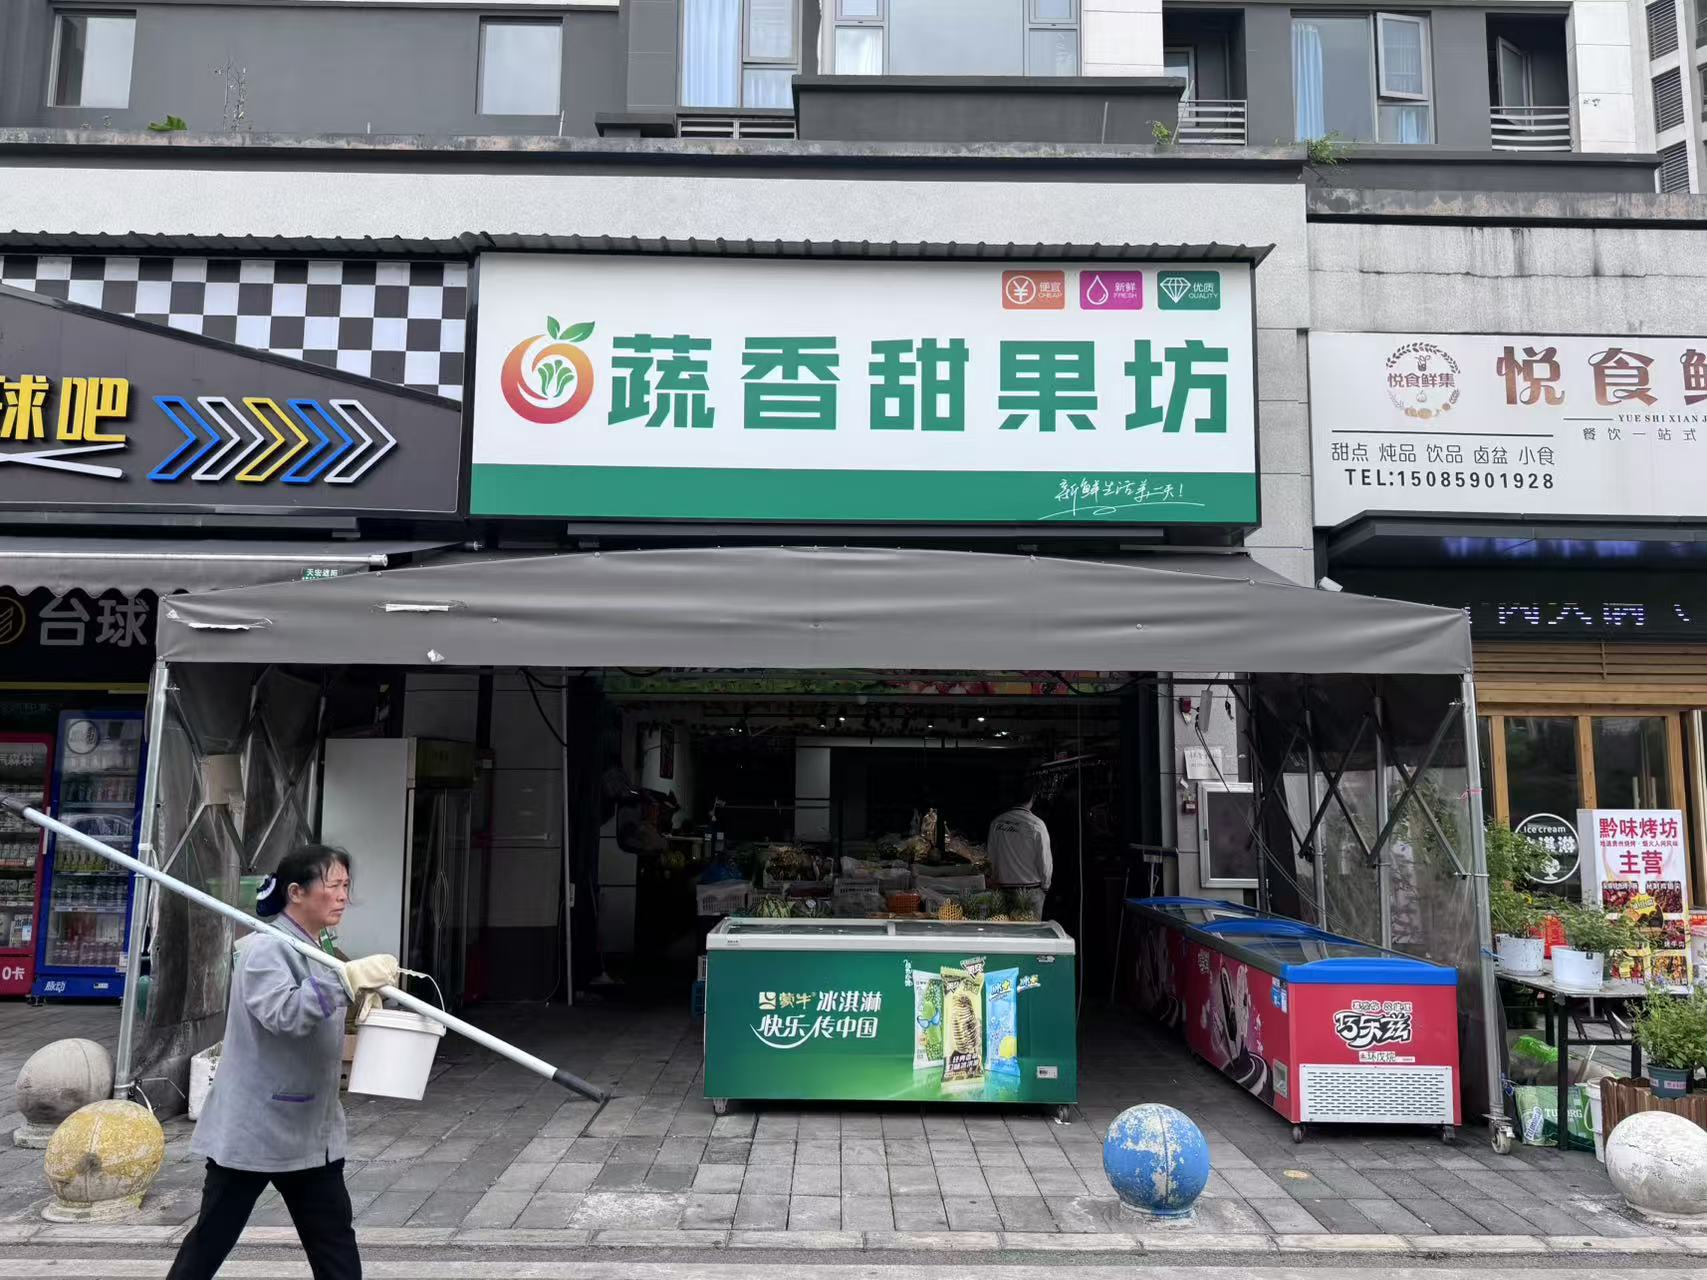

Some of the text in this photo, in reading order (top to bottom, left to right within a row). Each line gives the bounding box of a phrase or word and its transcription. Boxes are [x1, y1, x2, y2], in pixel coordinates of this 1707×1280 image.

[1039, 281, 1061, 292] 便宜
[1114, 281, 1136, 293] 新鲜
[1193, 282, 1214, 293] 优质
[607, 333, 1229, 434] 蔬香甜果坊
[1386, 372, 1456, 389] 悦食鲜集
[0, 374, 129, 442] 球吧
[1619, 414, 1642, 423] YUE
[1644, 414, 1666, 423] SHI
[1669, 414, 1699, 423] XIAN
[1331, 442, 1556, 466] 甜点 炖品 饮品 卤盆 小食
[1344, 468, 1555, 489] TEL:15085901928
[38, 597, 150, 647] 台球
[1599, 817, 1678, 839] 黔味烤坊
[1619, 850, 1663, 875] 主营
[816, 990, 883, 1013] 冰淇淋
[1335, 1012, 1410, 1048] 巧乐兹
